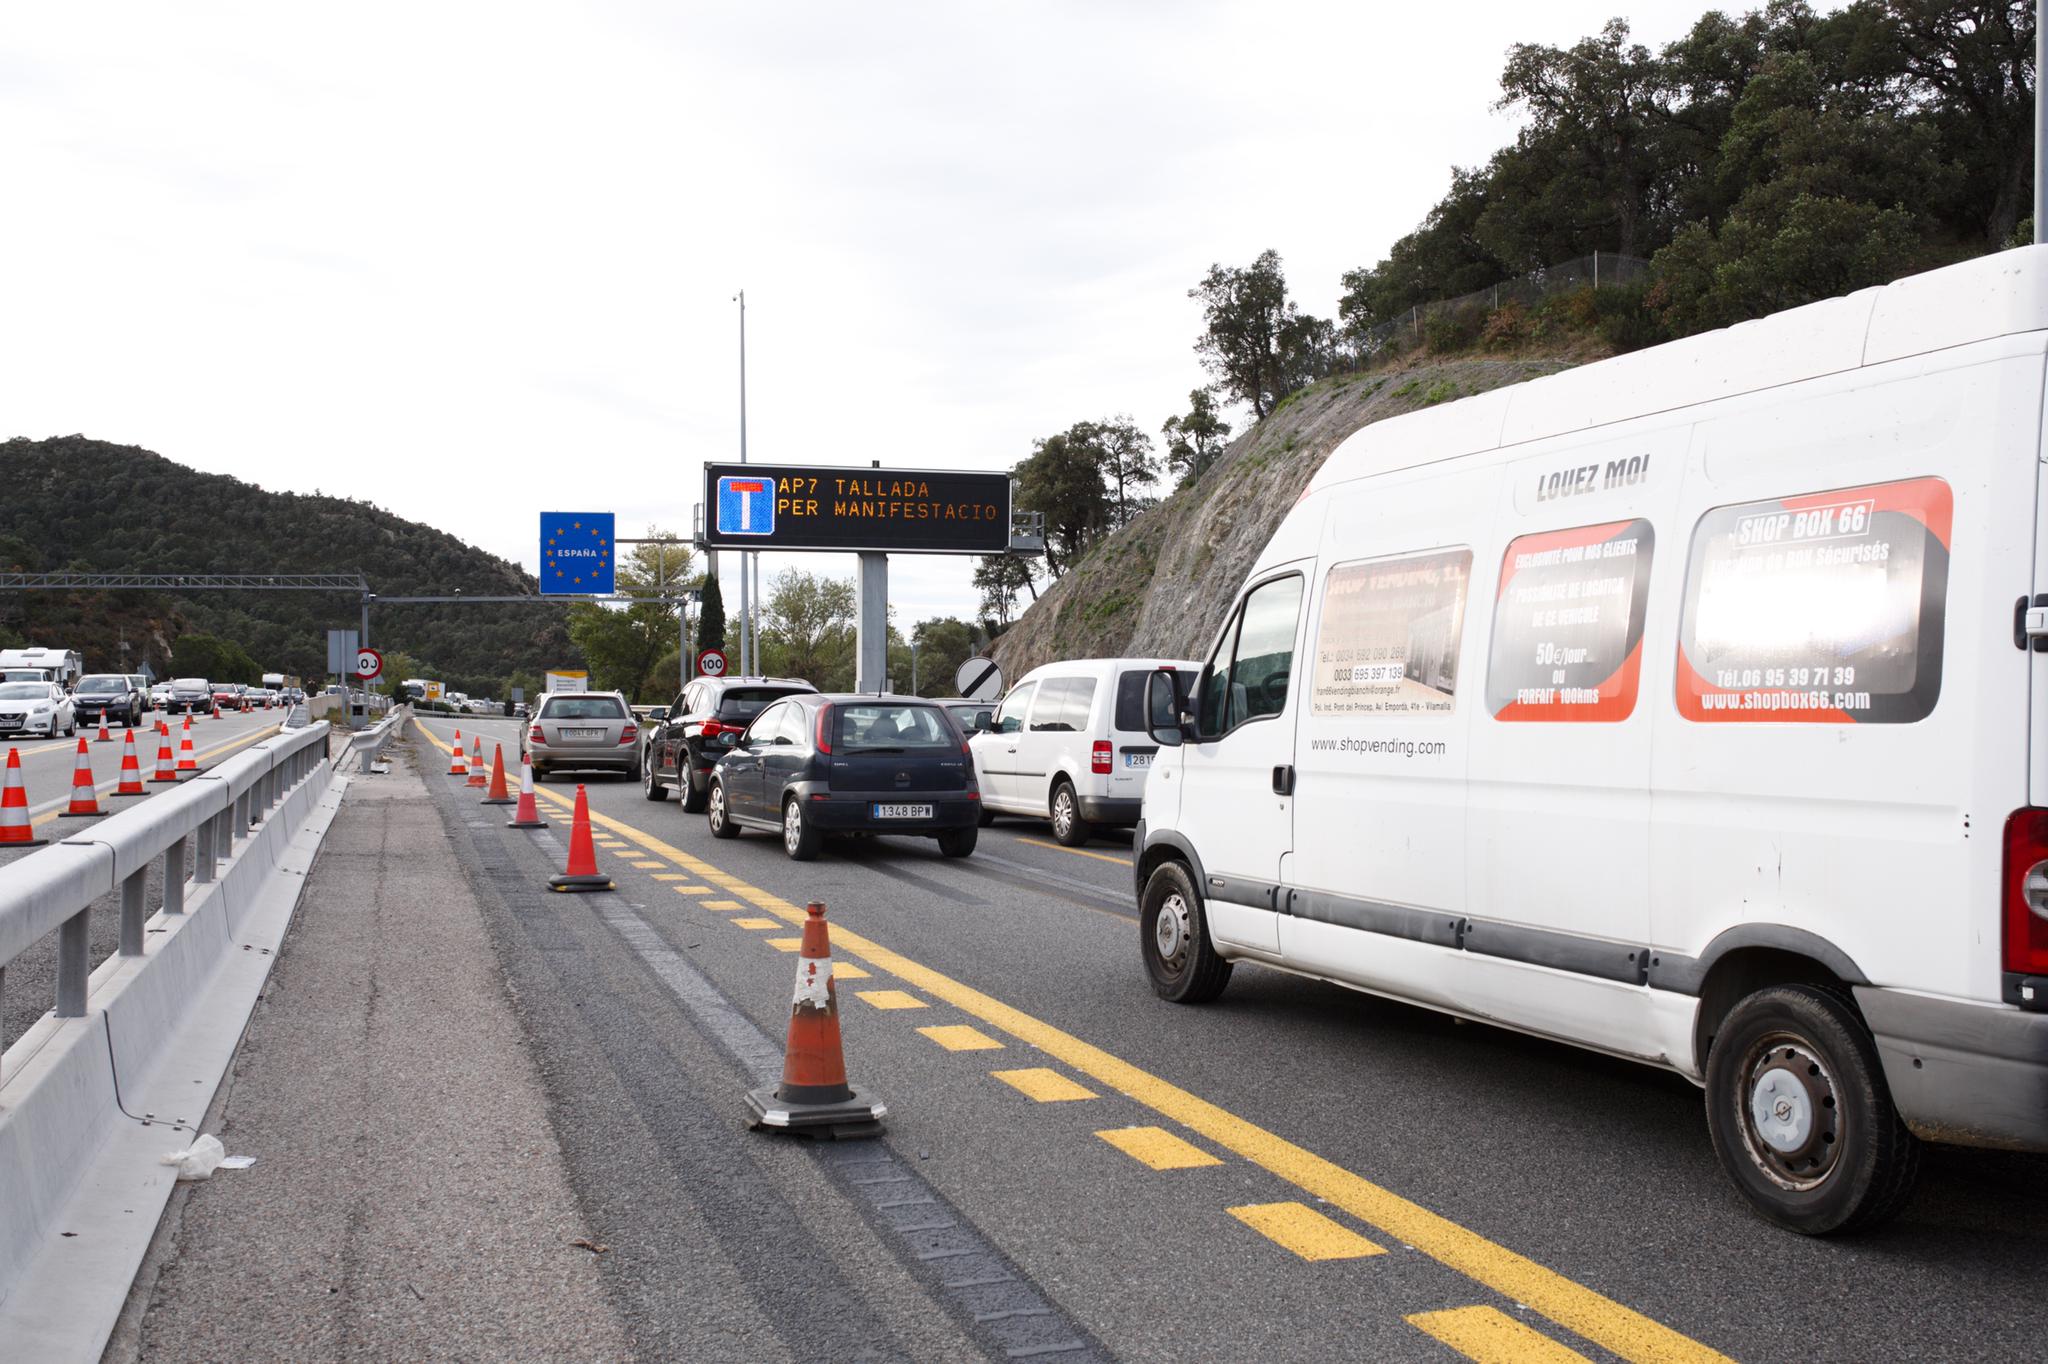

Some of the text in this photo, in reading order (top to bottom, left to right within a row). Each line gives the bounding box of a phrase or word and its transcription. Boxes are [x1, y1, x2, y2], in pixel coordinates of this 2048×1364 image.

[779, 478, 930, 498] AP7 TALLADA
[1537, 454, 1650, 502] LOUEZ MOI
[778, 499, 998, 520] PER MANIFESTACIO
[1738, 505, 1866, 545] SHOP BOX 66
[558, 548, 597, 557] ESPAÑA
[1603, 538, 1638, 558] CLIENTS
[1816, 539, 1890, 565] Sécurisés
[702, 659, 723, 669] 100
[1334, 666, 1403, 682] 0033 695 397 139
[1765, 668, 1785, 686] 95
[1789, 668, 1809, 686] 39
[1812, 667, 1830, 686] 71
[1833, 666, 1855, 686] 39
[1517, 688, 1555, 705] FORFAIT
[1702, 691, 1871, 711] www.shopbox66.com
[1311, 737, 1446, 757] www.shopvending.com
[882, 806, 930, 817] 1348 BPW
